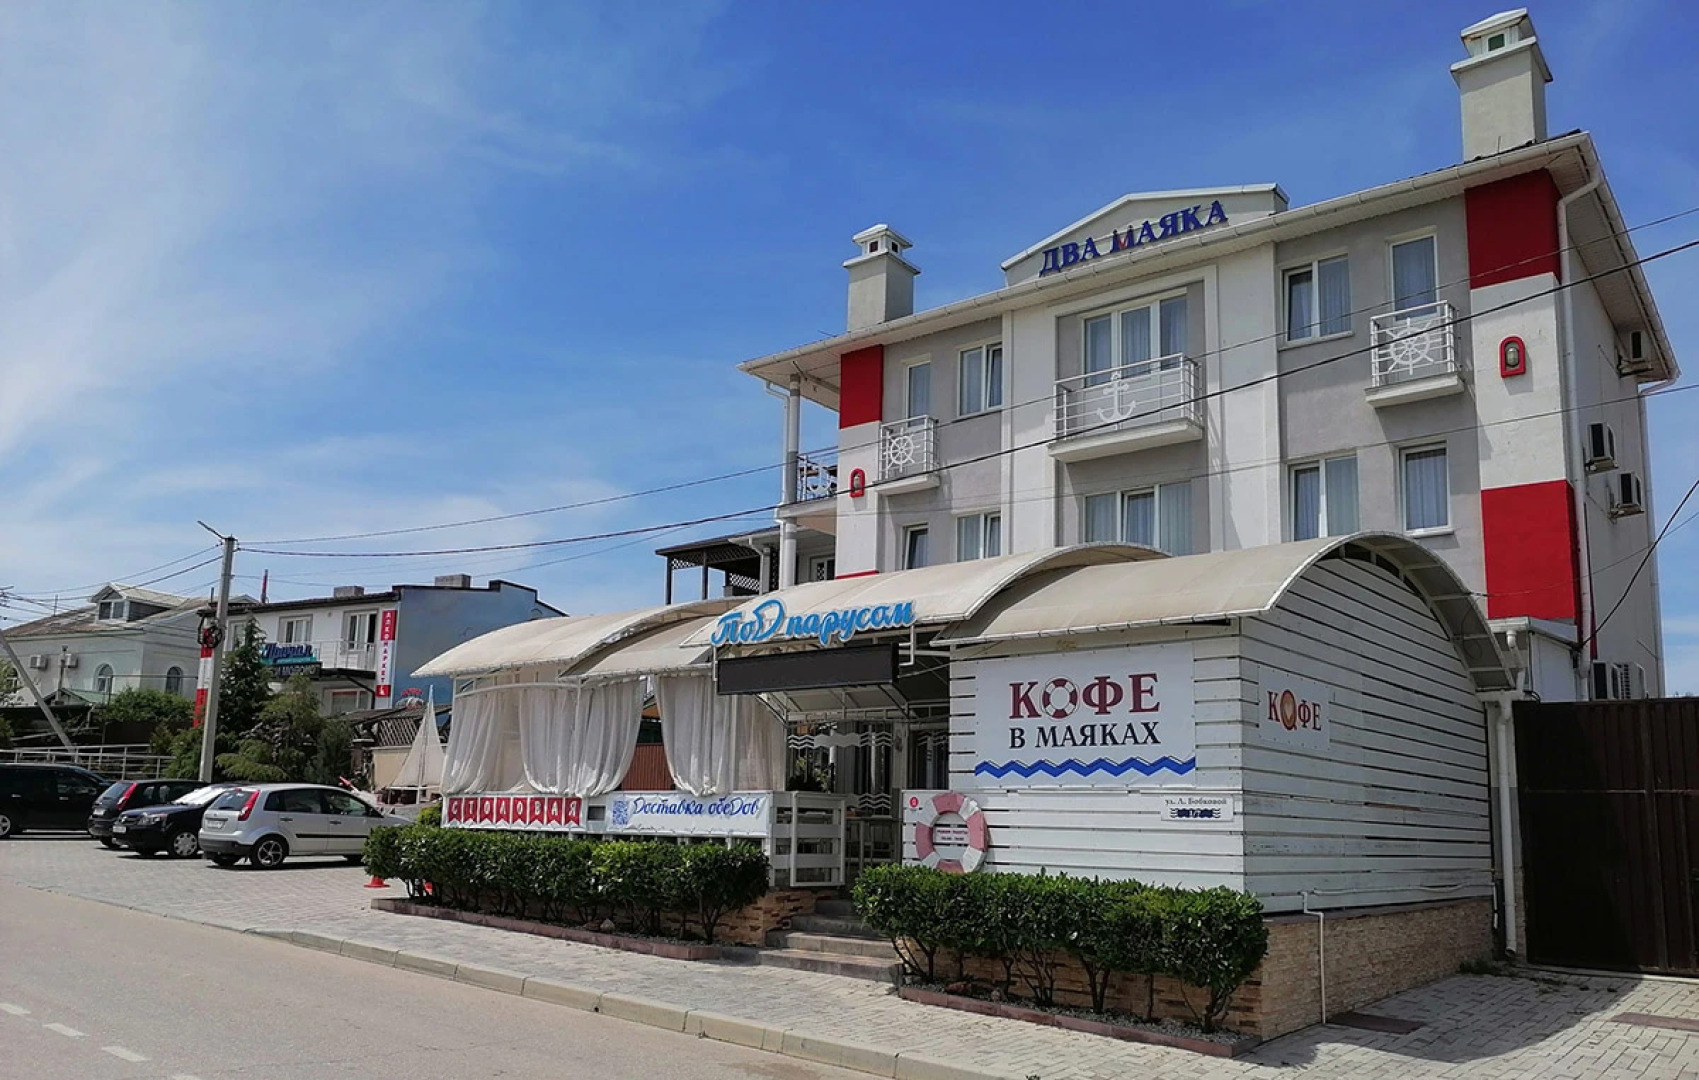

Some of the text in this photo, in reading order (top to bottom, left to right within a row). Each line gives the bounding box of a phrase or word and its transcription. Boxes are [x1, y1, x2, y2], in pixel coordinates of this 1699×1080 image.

[1039, 200, 1229, 277] ДВА МАЯКА
[786, 601, 915, 645] парусом
[380, 611, 392, 683] АЛКОМАРКЕТ
[1009, 672, 1161, 719] КОФЕ
[1267, 689, 1322, 731] КОФЕ
[1009, 721, 1161, 749] В МАЯКАХ
[451, 800, 577, 817] СТОЛОВАЯ
[633, 797, 703, 816] Доставка
